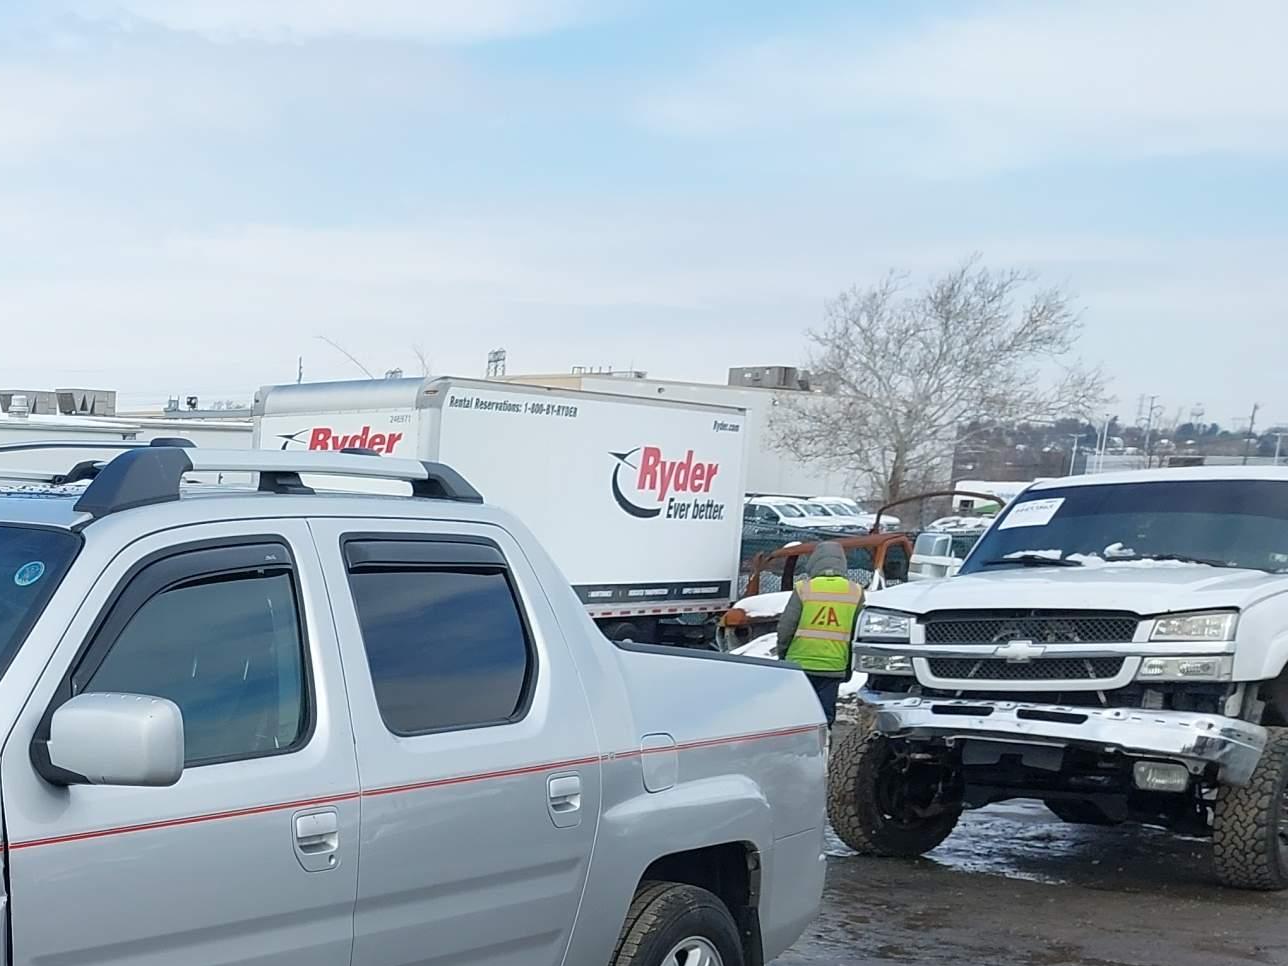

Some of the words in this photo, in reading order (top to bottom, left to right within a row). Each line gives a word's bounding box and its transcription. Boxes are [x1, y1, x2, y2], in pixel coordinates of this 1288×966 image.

[449, 396, 472, 408] Rental
[475, 398, 522, 413] Reservations:
[524, 402, 578, 417] 1-800-BY-RYDER
[712, 420, 740, 432] Ryder.com
[637, 446, 719, 502] Ryder
[666, 498, 691, 519] Ever
[692, 499, 724, 520] better.
